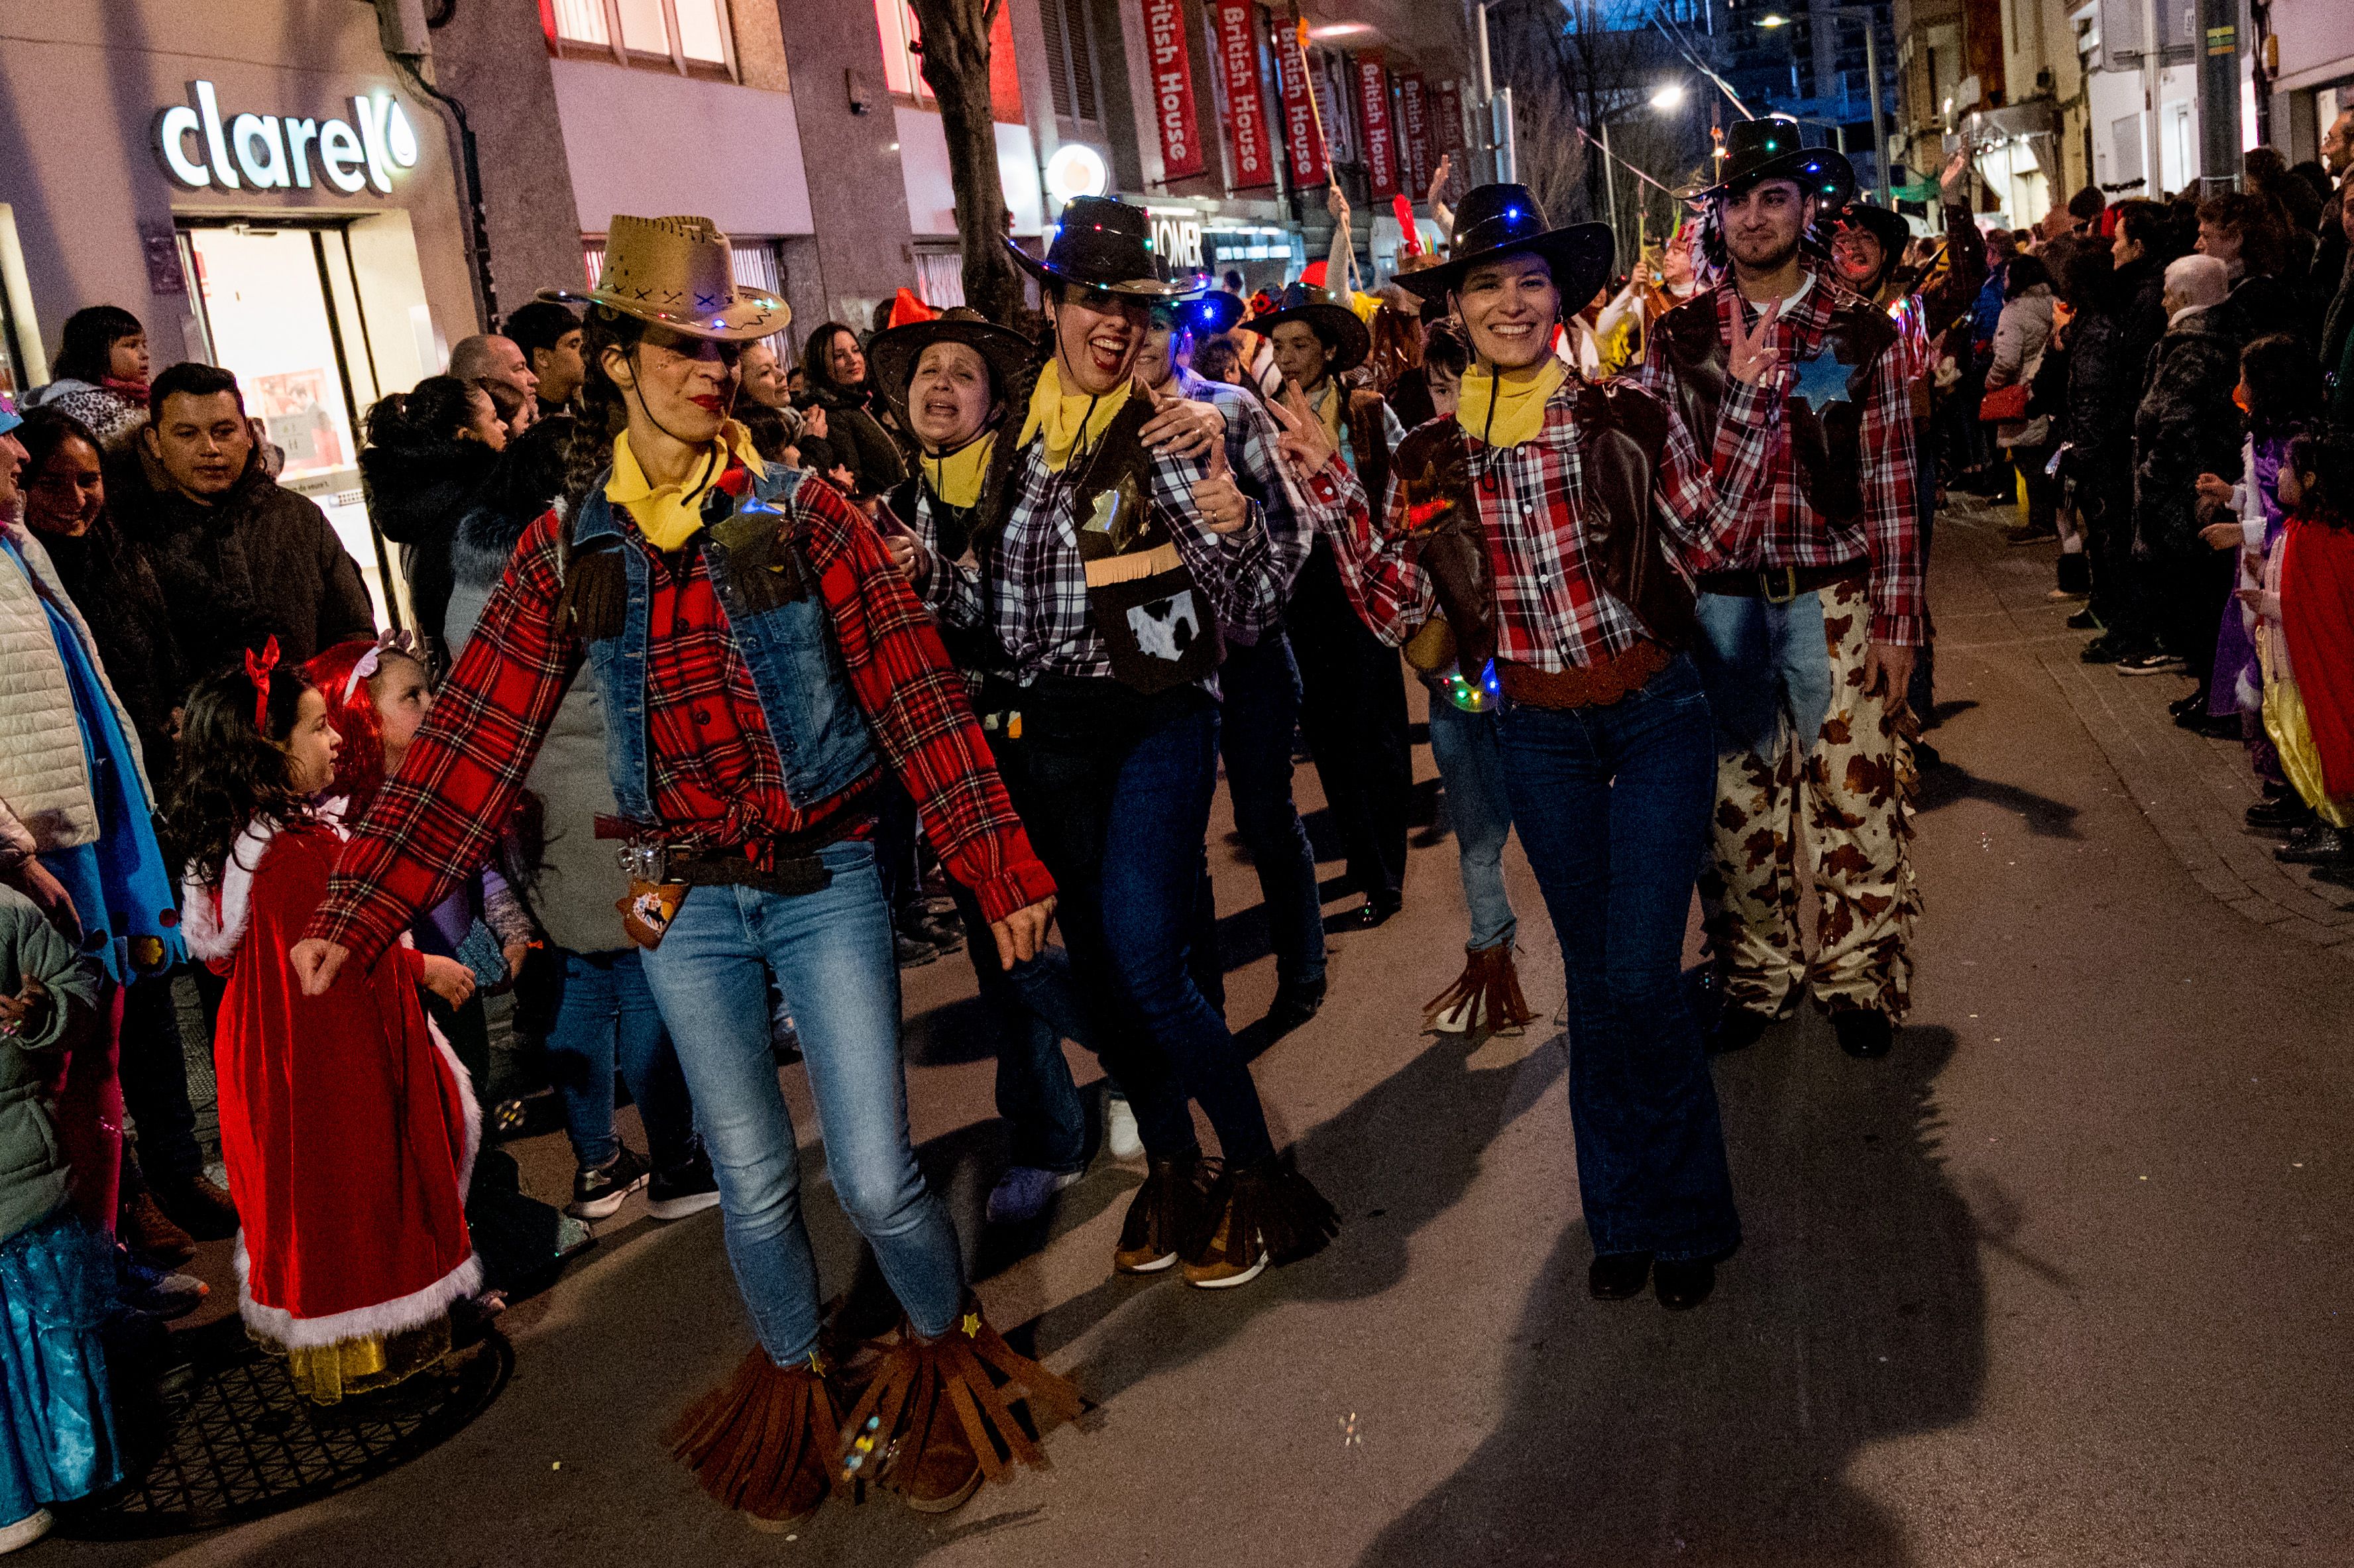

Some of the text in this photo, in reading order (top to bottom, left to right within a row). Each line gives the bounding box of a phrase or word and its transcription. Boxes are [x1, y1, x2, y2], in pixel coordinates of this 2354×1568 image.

[162, 80, 392, 194] clarel
[1159, 72, 1187, 161] House
[1223, 7, 1258, 172] British House
[1280, 26, 1312, 174] British House
[1363, 63, 1388, 188] British House
